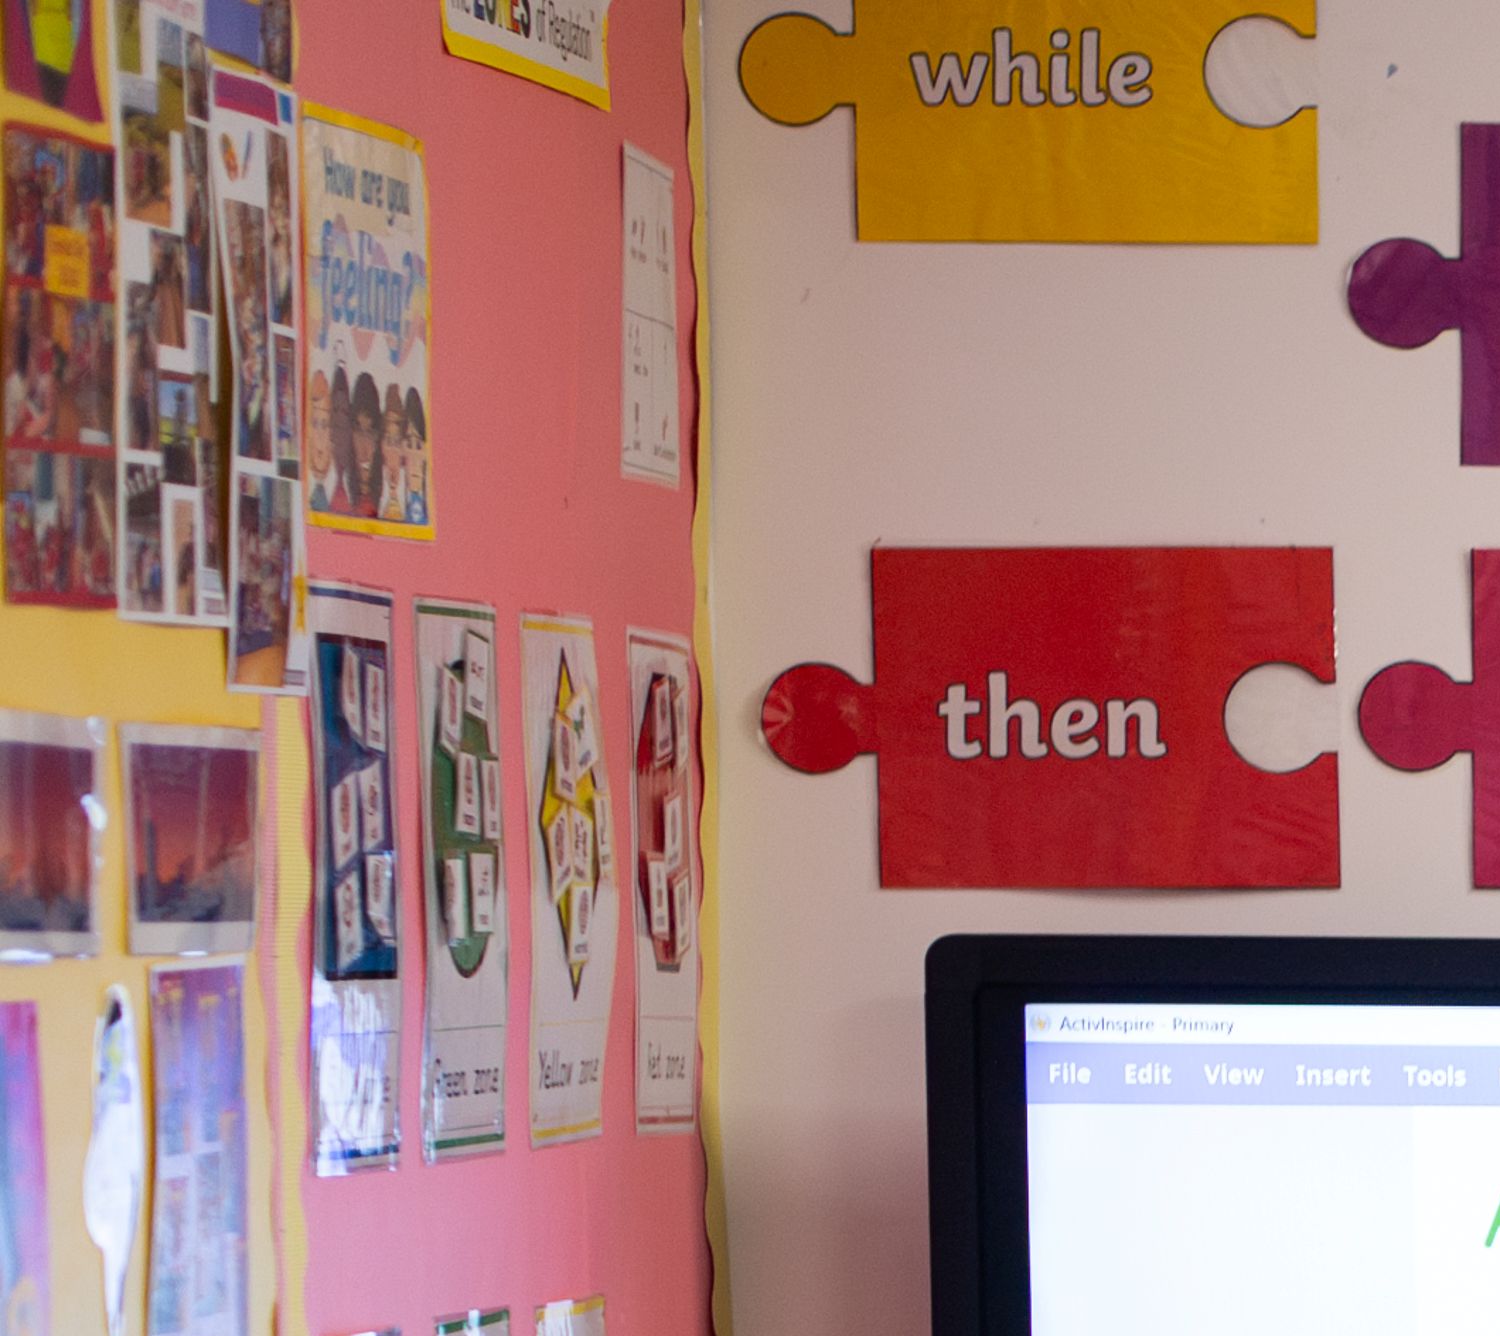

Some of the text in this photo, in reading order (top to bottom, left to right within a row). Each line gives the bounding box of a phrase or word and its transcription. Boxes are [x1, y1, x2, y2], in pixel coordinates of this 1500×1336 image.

[909, 26, 1154, 108] while
[319, 219, 413, 366] feeling?
[936, 671, 1168, 762] then
[1059, 1015, 1235, 1036] ActivInspire Primary
[1048, 1062, 1092, 1085] File
[1124, 1063, 1172, 1086] Edit
[1203, 1064, 1266, 1087] View
[1295, 1065, 1372, 1088] Insert
[1402, 1065, 1468, 1088] Tools
